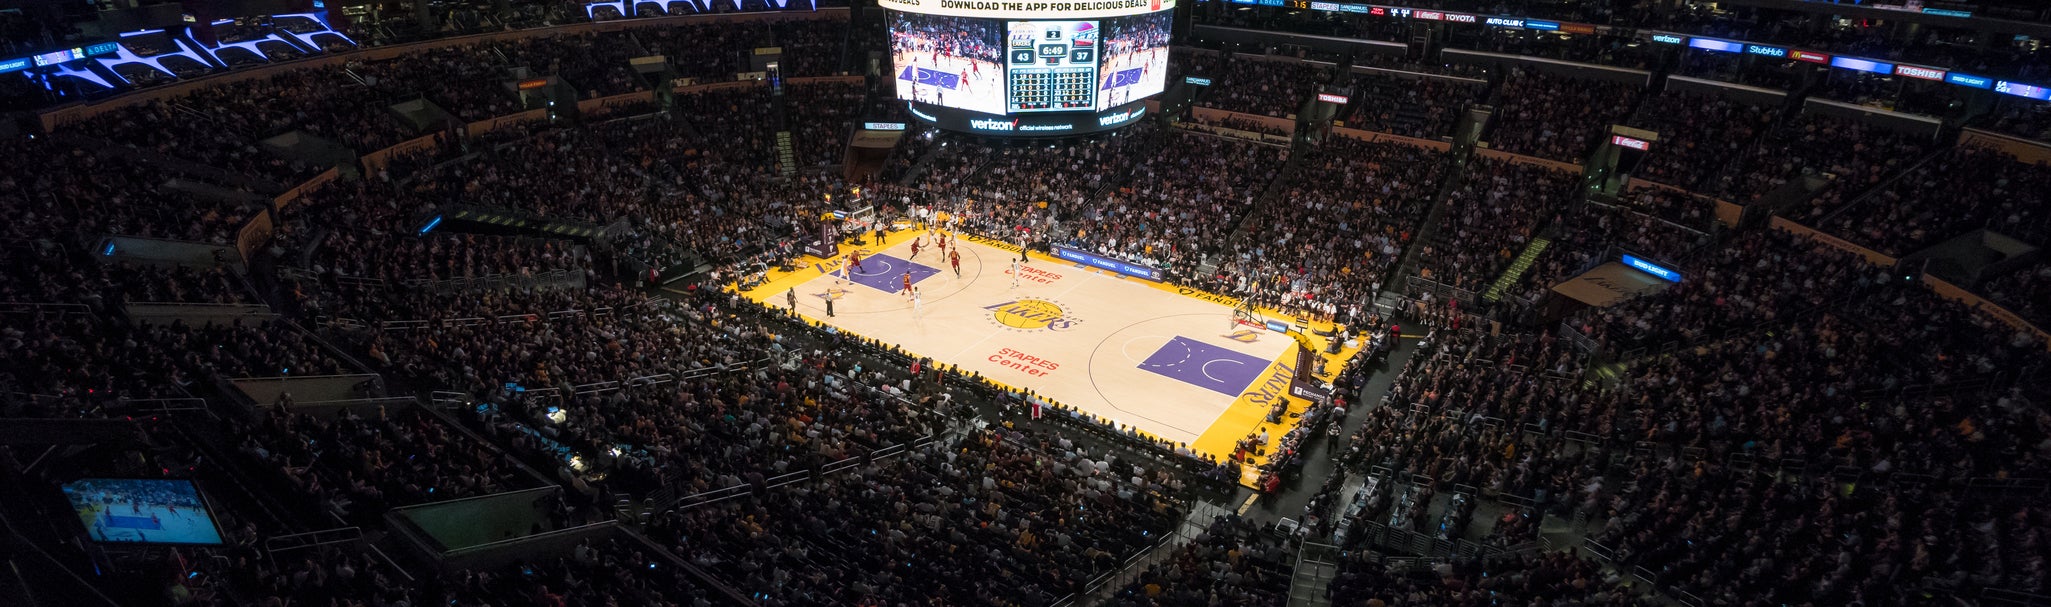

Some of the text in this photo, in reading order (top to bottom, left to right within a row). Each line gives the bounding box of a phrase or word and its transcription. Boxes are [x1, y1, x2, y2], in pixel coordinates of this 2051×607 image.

[941, 0, 1148, 11] DOWNLOAD THE APP FOR DELICIOUS DEALS
[1445, 14, 1476, 22] TOYOTA
[1653, 35, 1680, 44] verizon
[95, 43, 117, 53] DELTA
[1043, 46, 1063, 55] 6:49
[1750, 45, 1783, 56] StubHub
[1017, 52, 1088, 61] 43 37
[1897, 66, 1944, 80] TOSHIBA
[1319, 94, 1347, 103] TOSHIBA
[970, 118, 1013, 131] verizon
[1099, 113, 1129, 126] verizon
[1066, 252, 1085, 261] FANDUEL
[1097, 260, 1117, 269] FANDUEL
[1004, 268, 1054, 284] Cnter
[1129, 267, 1149, 277] FANDUEL
[1648, 264, 1669, 277] LIGHT
[982, 300, 1079, 331] LAKERS
[998, 347, 1060, 370] STAPLES
[988, 354, 1049, 377] Center
[1242, 361, 1295, 408] LAKERS
